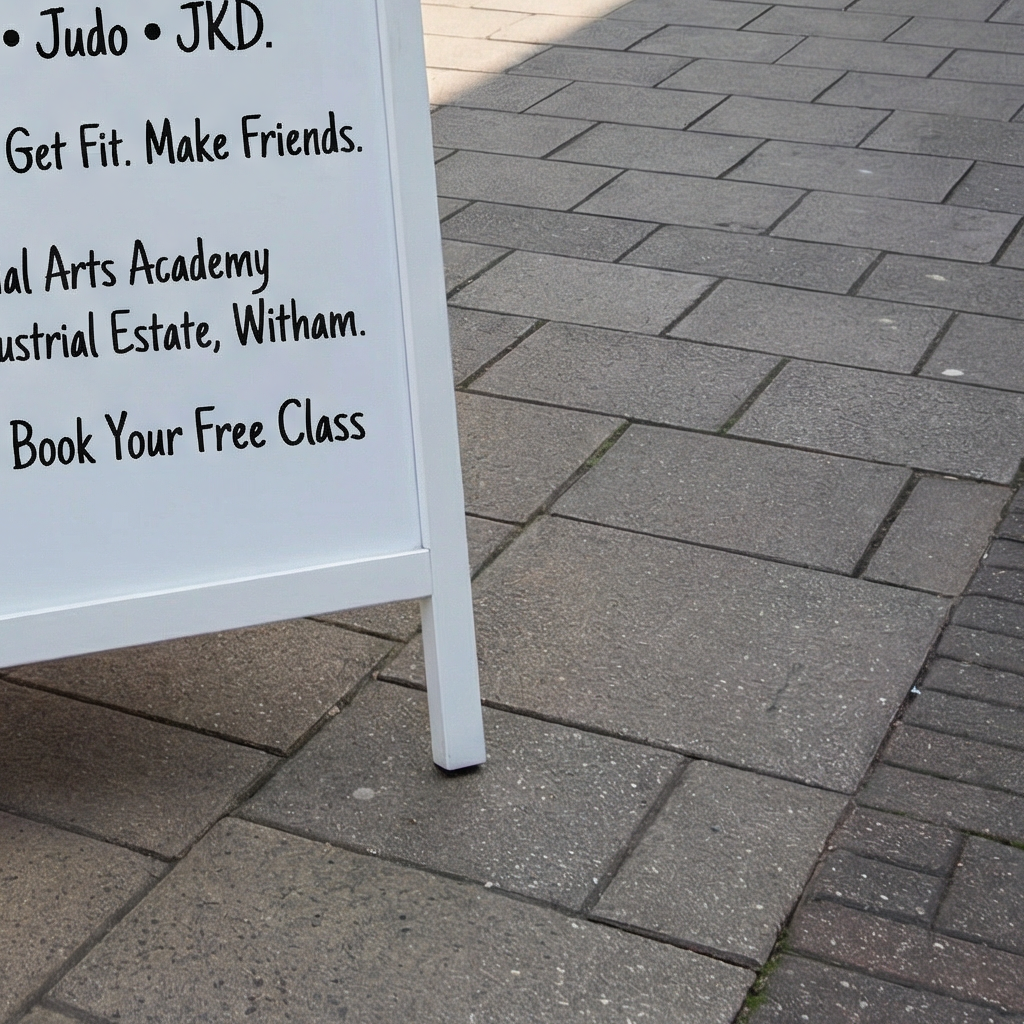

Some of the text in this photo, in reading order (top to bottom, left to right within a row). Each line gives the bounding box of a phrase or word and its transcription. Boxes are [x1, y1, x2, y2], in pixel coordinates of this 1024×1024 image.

[35, 5, 129, 60] Judo
[5, 123, 68, 175] Get
[79, 123, 131, 170] Fit.
[145, 116, 231, 167] Make
[241, 110, 364, 160] Friends.
[44, 244, 118, 292] Arts
[129, 236, 271, 295] Academy
[110, 309, 222, 356] Estate,
[232, 297, 368, 347] Witham.
[9, 416, 98, 471] Book
[104, 410, 184, 463] Your
[194, 404, 268, 455] Free
[278, 397, 367, 449] Class
